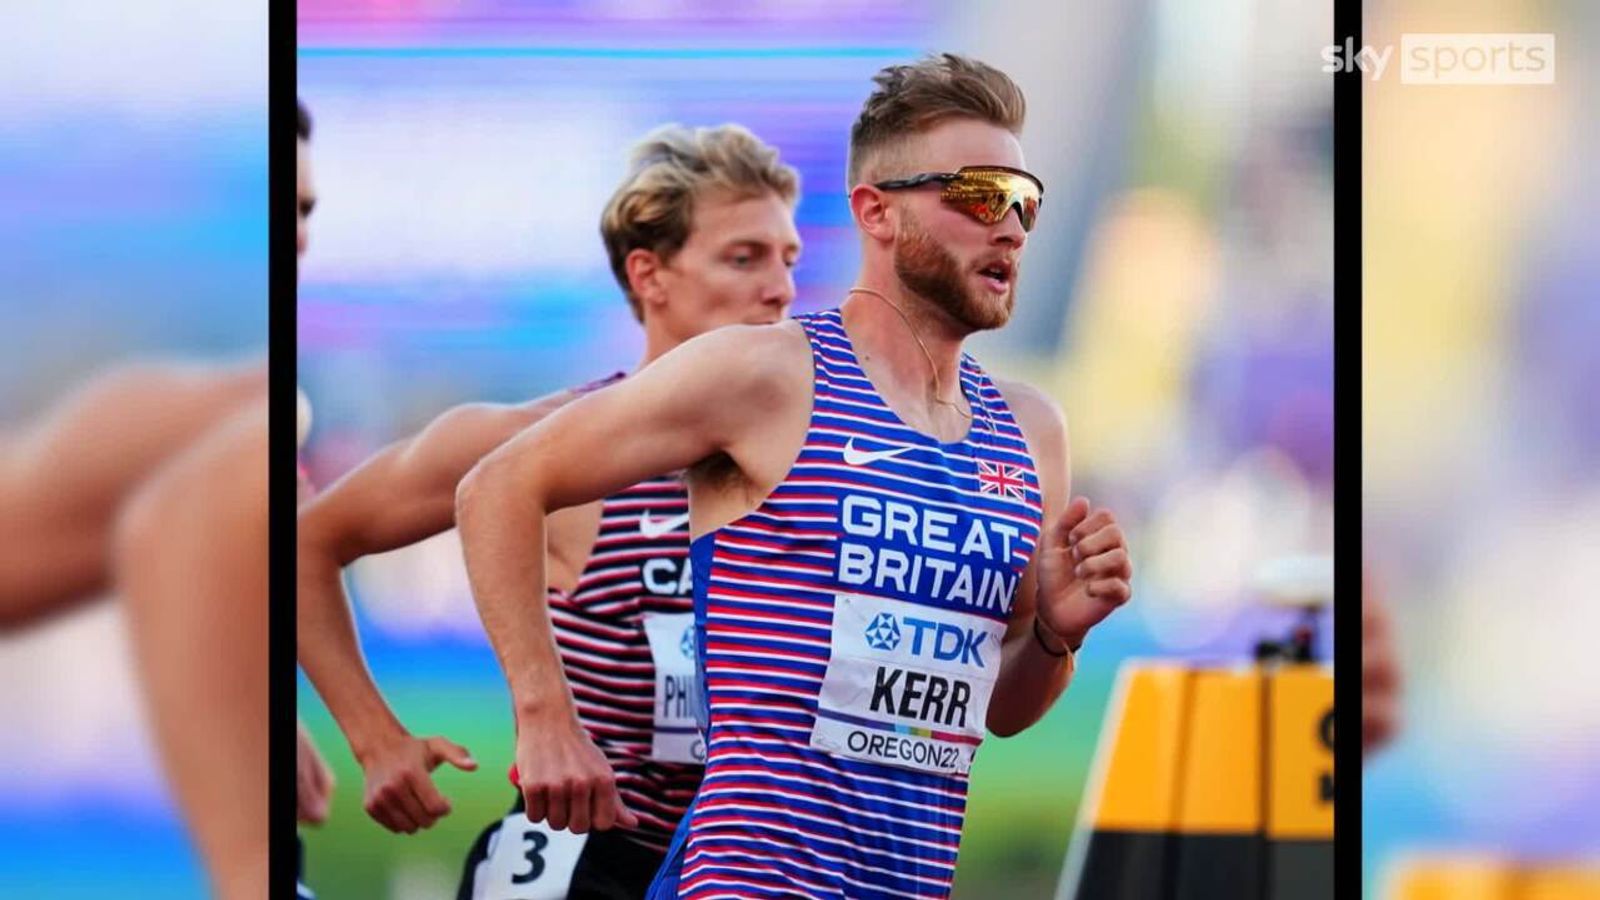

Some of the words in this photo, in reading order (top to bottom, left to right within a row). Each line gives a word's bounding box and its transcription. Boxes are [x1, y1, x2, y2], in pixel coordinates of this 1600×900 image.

[842, 495, 1019, 563] GREAT
[838, 543, 1016, 614] BRITAIN
[903, 617, 988, 668] TDK
[869, 666, 971, 728] KERR
[847, 731, 960, 769] OREGON22
[511, 831, 548, 884] 3
